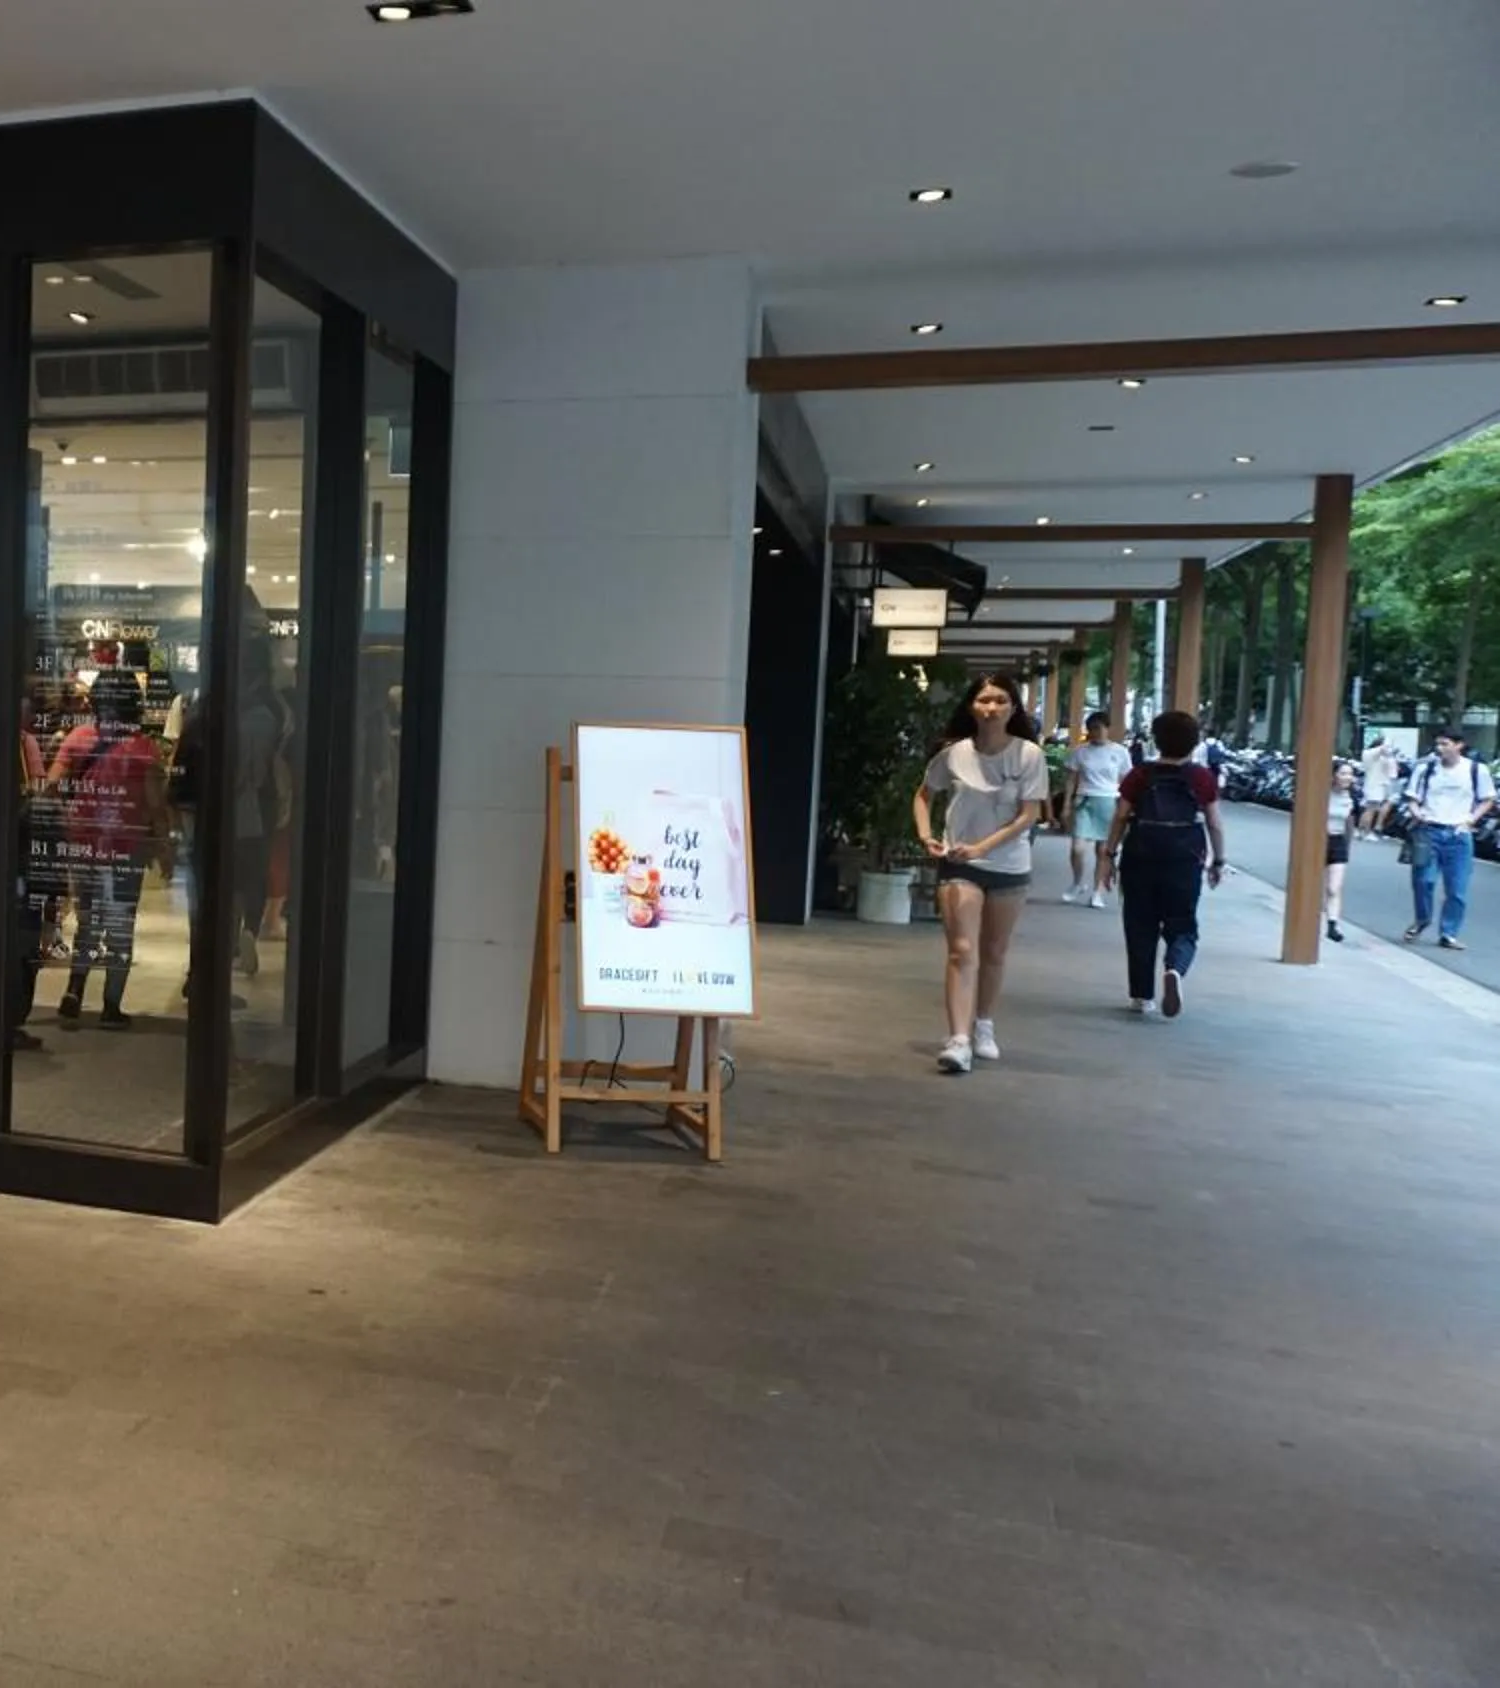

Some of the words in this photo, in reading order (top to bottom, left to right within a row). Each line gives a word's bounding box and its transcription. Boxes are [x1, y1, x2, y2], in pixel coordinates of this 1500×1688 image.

[33, 713, 52, 729] 2F
[664, 824, 701, 851] best
[30, 840, 48, 856] B1
[663, 850, 702, 880] day
[659, 882, 705, 900] ever
